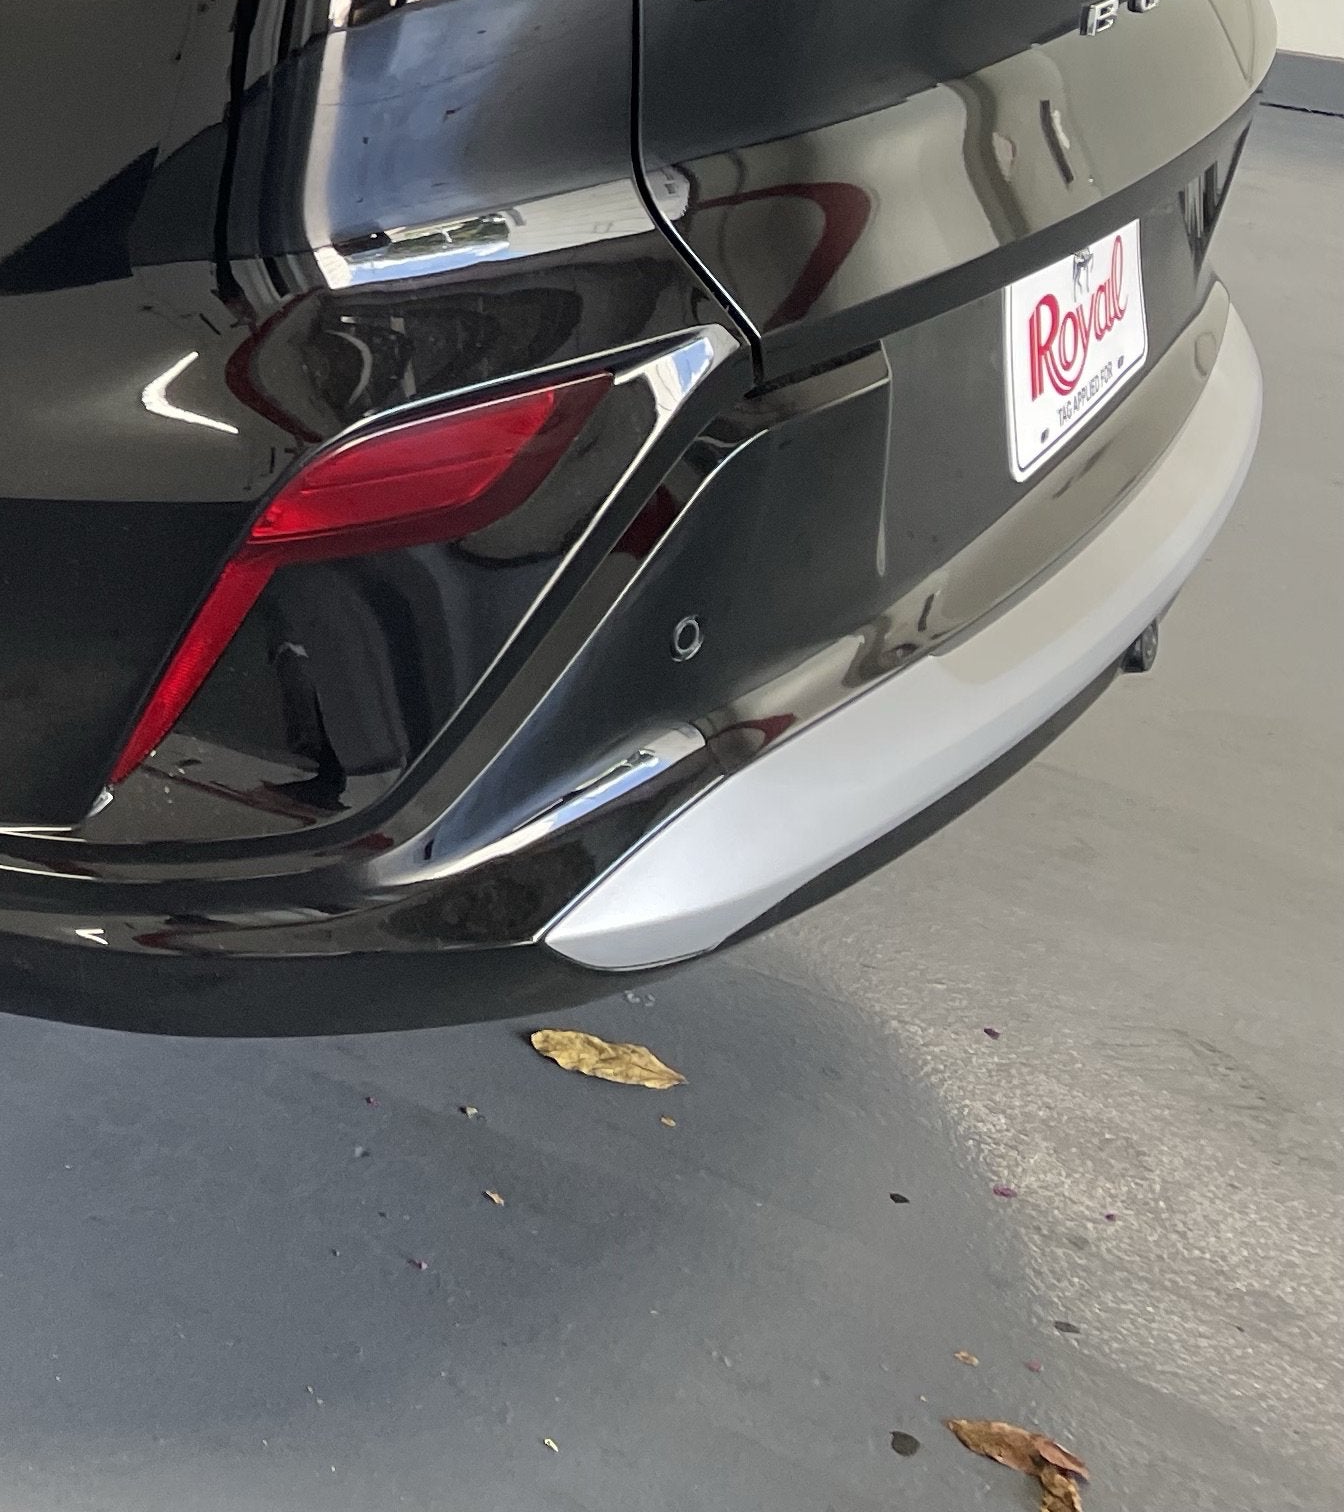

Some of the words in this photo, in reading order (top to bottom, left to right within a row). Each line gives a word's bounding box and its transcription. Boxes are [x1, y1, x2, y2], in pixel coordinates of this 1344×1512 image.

[1028, 234, 1129, 403] Royal
[1057, 399, 1073, 427] TAG
[1073, 374, 1100, 414] APPLIED
[1100, 361, 1113, 388] FOR
